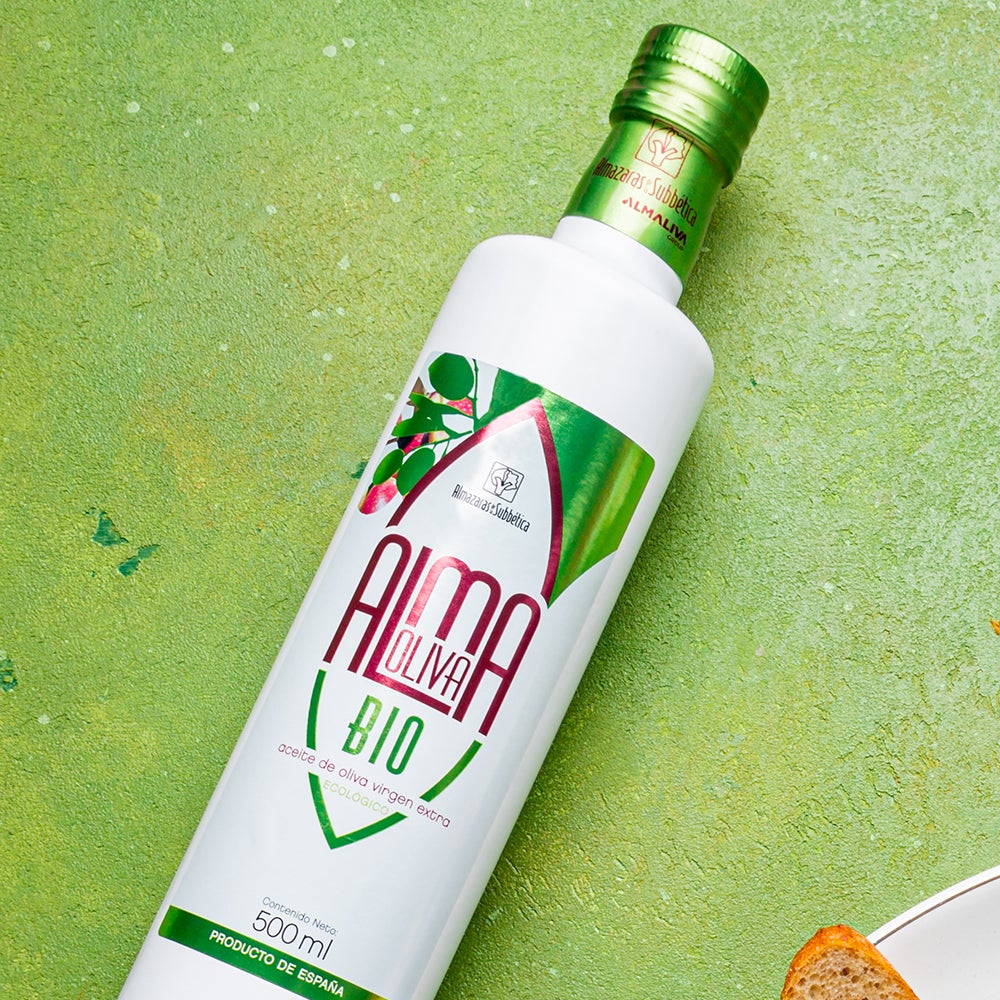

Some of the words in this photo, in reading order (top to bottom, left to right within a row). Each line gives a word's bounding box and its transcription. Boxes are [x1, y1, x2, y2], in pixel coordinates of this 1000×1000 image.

[622, 197, 687, 246] ALMALIVA
[451, 483, 492, 513] Almazaras
[493, 503, 531, 533] Subbética
[323, 533, 541, 737] ALMA
[385, 629, 471, 701] OLIVA
[342, 694, 425, 776] BIO
[278, 742, 316, 765] aceite
[318, 758, 336, 775] de
[338, 767, 369, 788] oliva
[372, 782, 414, 810] virgen
[416, 803, 451, 829] extra
[322, 779, 390, 816] ECOLÓGICO
[252, 910, 299, 945] 500
[298, 933, 334, 961] ml
[262, 896, 311, 924] Contenido
[312, 918, 339, 937] Neto:
[209, 929, 276, 966] PRODUCTO
[276, 958, 297, 976] DE
[297, 969, 345, 998] ESPAÑA
